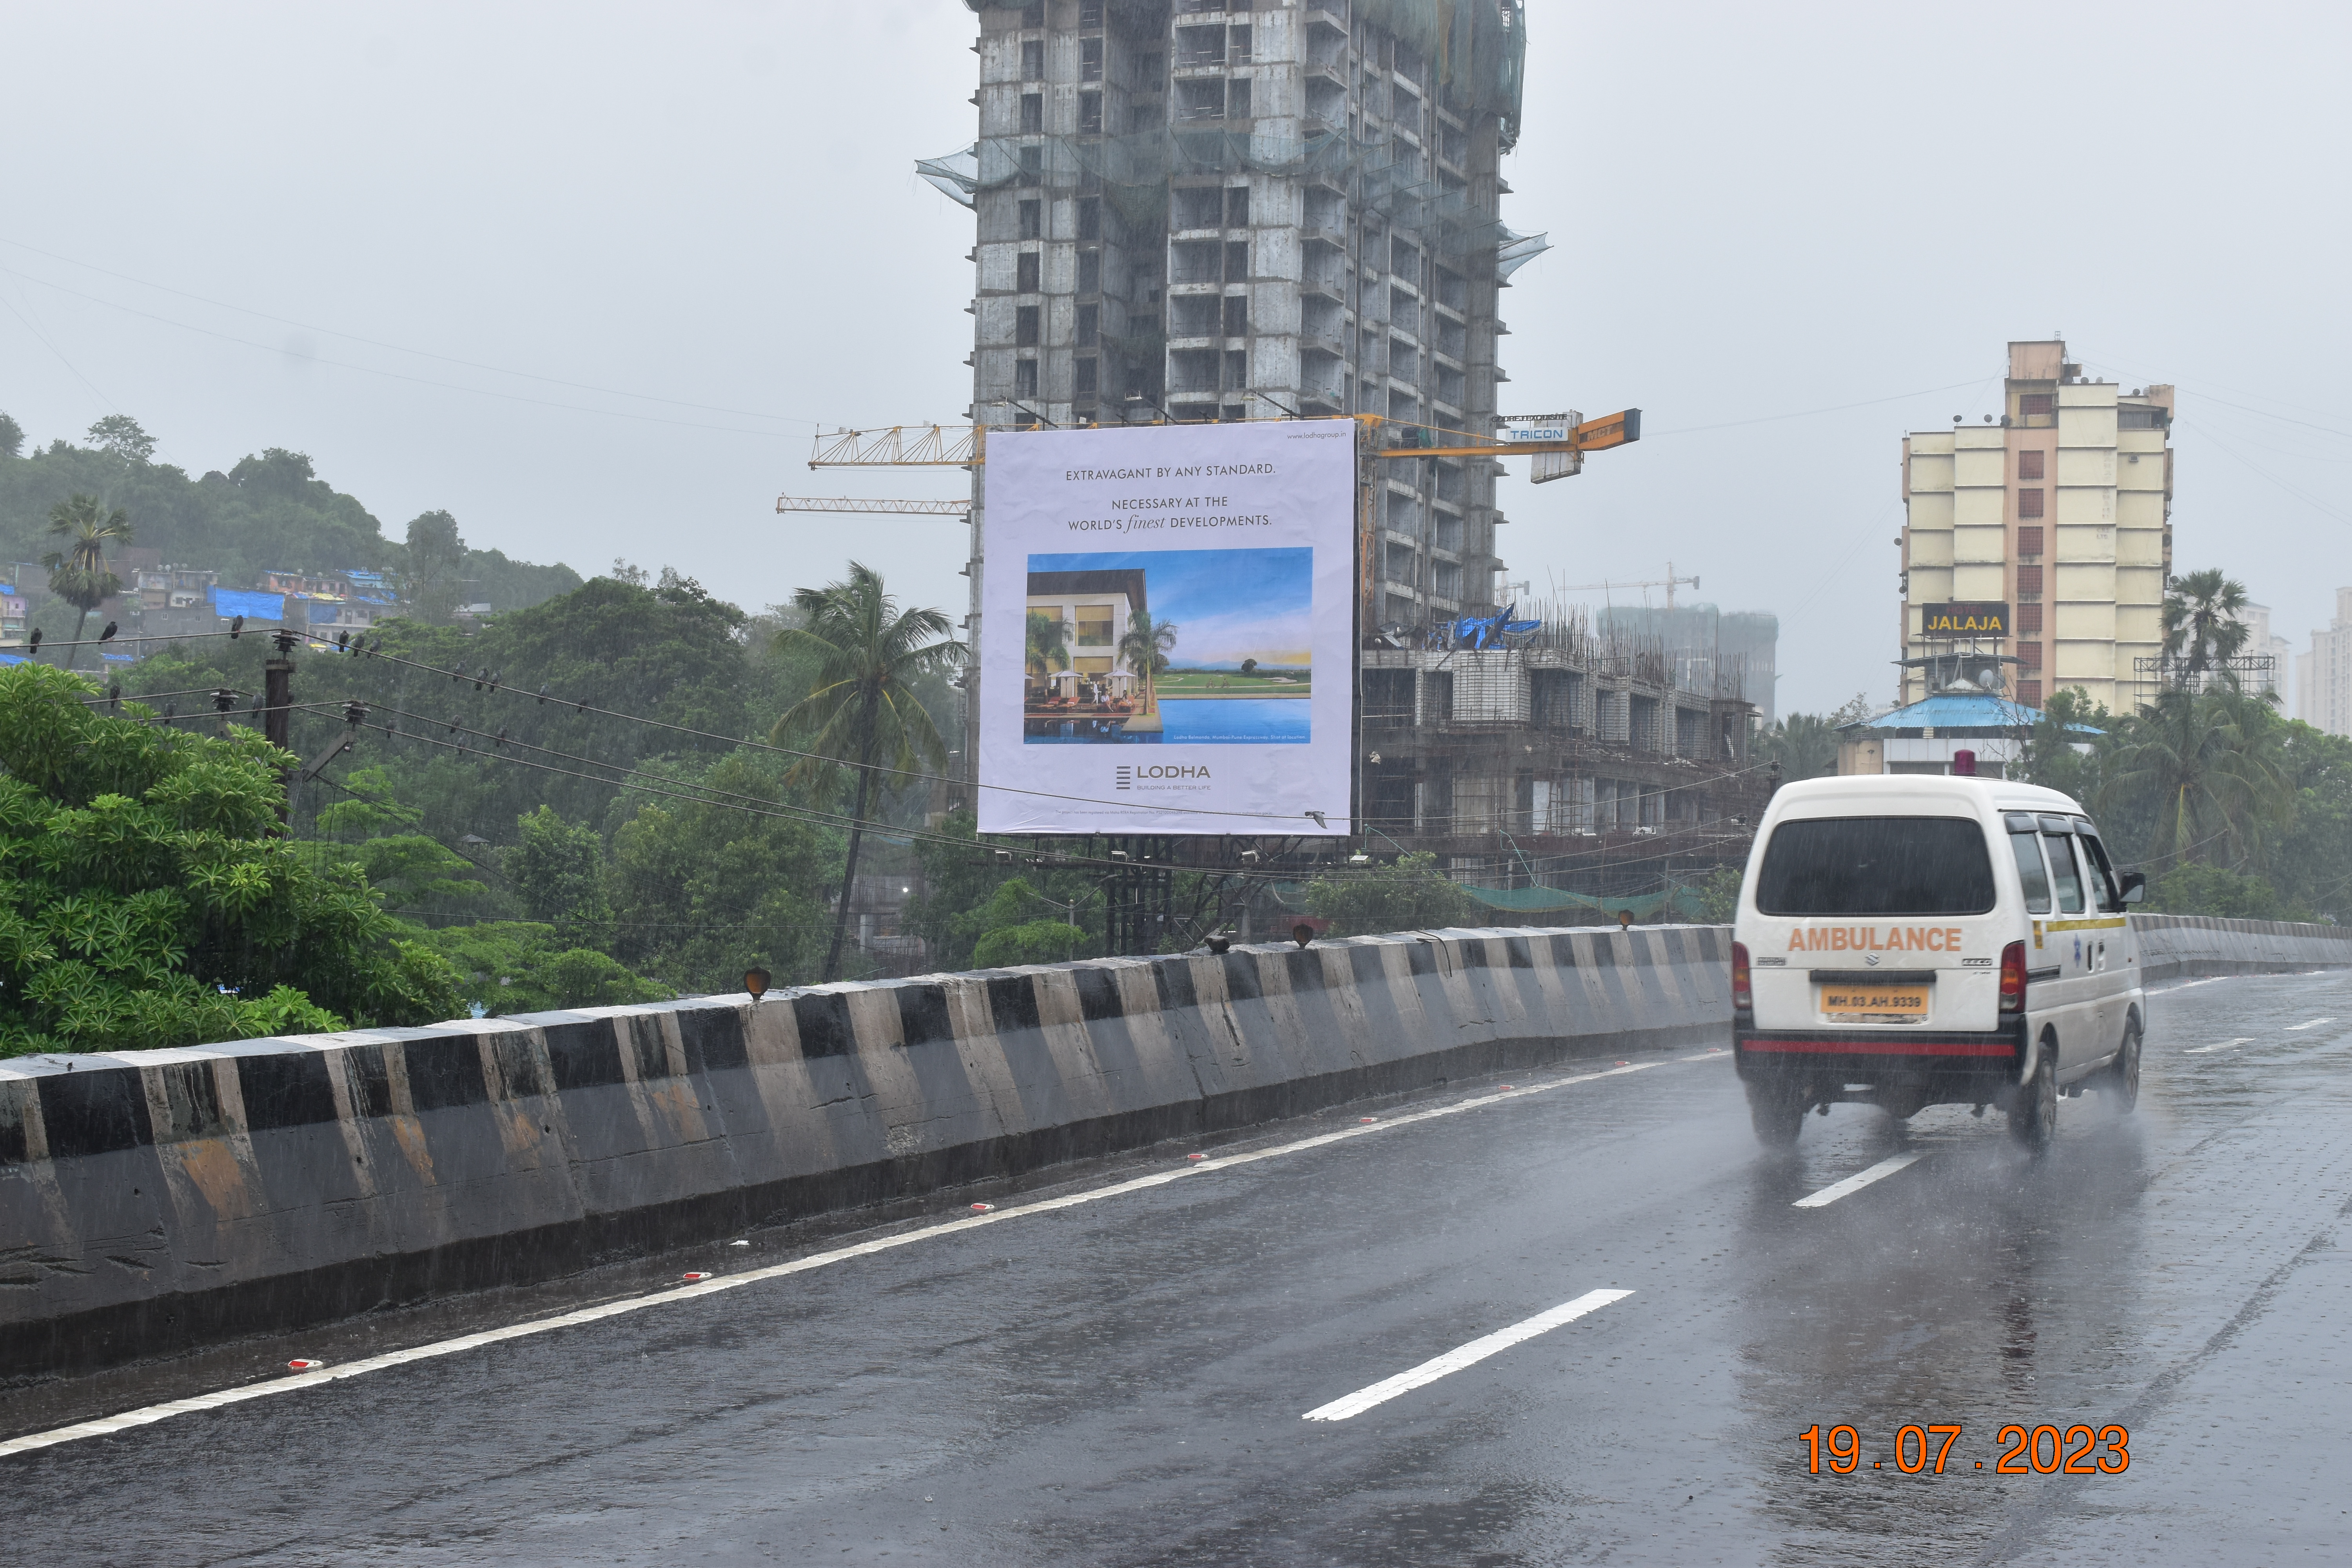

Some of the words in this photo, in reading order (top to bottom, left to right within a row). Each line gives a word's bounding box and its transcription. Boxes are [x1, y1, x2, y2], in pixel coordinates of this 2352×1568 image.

[1287, 431, 1346, 439] www.lodhagroup.in
[1510, 429, 1563, 439] TRICON
[1587, 425, 1612, 441] MCT
[1066, 468, 1152, 481] EXTRAVAGANT
[1157, 467, 1171, 477] BY
[1175, 466, 1202, 477] ANY
[1206, 464, 1276, 476] STANDARD.
[1112, 497, 1182, 510] NECESSARY
[1185, 497, 1200, 508] AT
[1205, 497, 1228, 507] THE
[1068, 519, 1122, 531] WORLD'S
[1123, 514, 1166, 534] finest
[1170, 515, 1272, 528] DEVELOPMENTS.
[1946, 606, 1984, 615] HOTEL
[1928, 615, 2002, 630] JALAJA
[1137, 766, 1211, 779] LODHA
[1788, 927, 1961, 951] AMBULANCE
